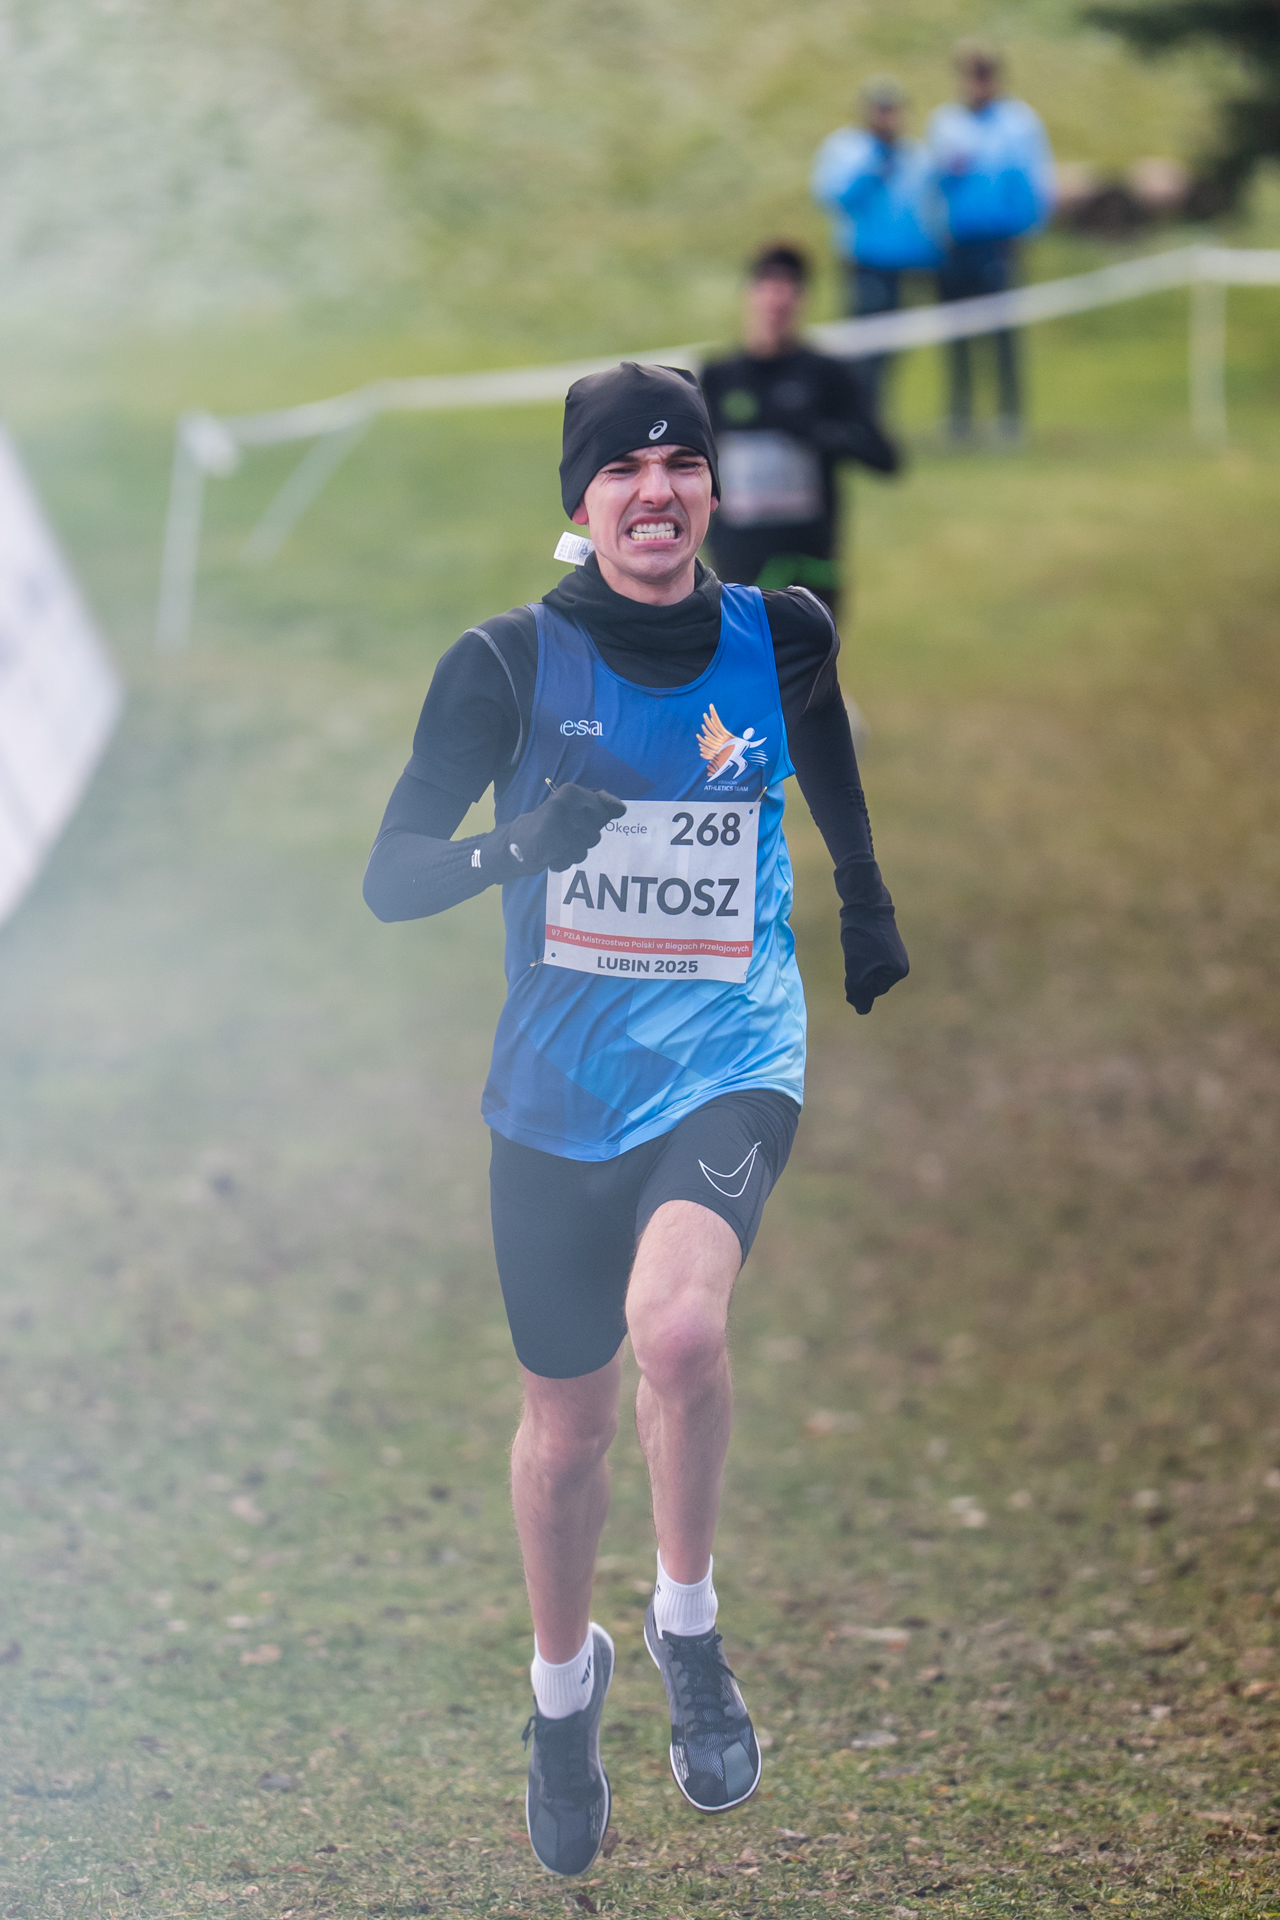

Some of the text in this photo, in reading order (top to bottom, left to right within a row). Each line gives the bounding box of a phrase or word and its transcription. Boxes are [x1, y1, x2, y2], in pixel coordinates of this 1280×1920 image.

[605, 821, 648, 836] Okęcie
[670, 812, 741, 846] 268
[562, 870, 740, 917] ANTOSZ
[551, 929, 562, 937] 97.
[563, 931, 581, 941] PZLA
[582, 935, 630, 947] Mistrzostwa
[631, 941, 655, 949] Polski
[665, 942, 698, 951] Biegach
[597, 956, 699, 973] LUBIN 2025
